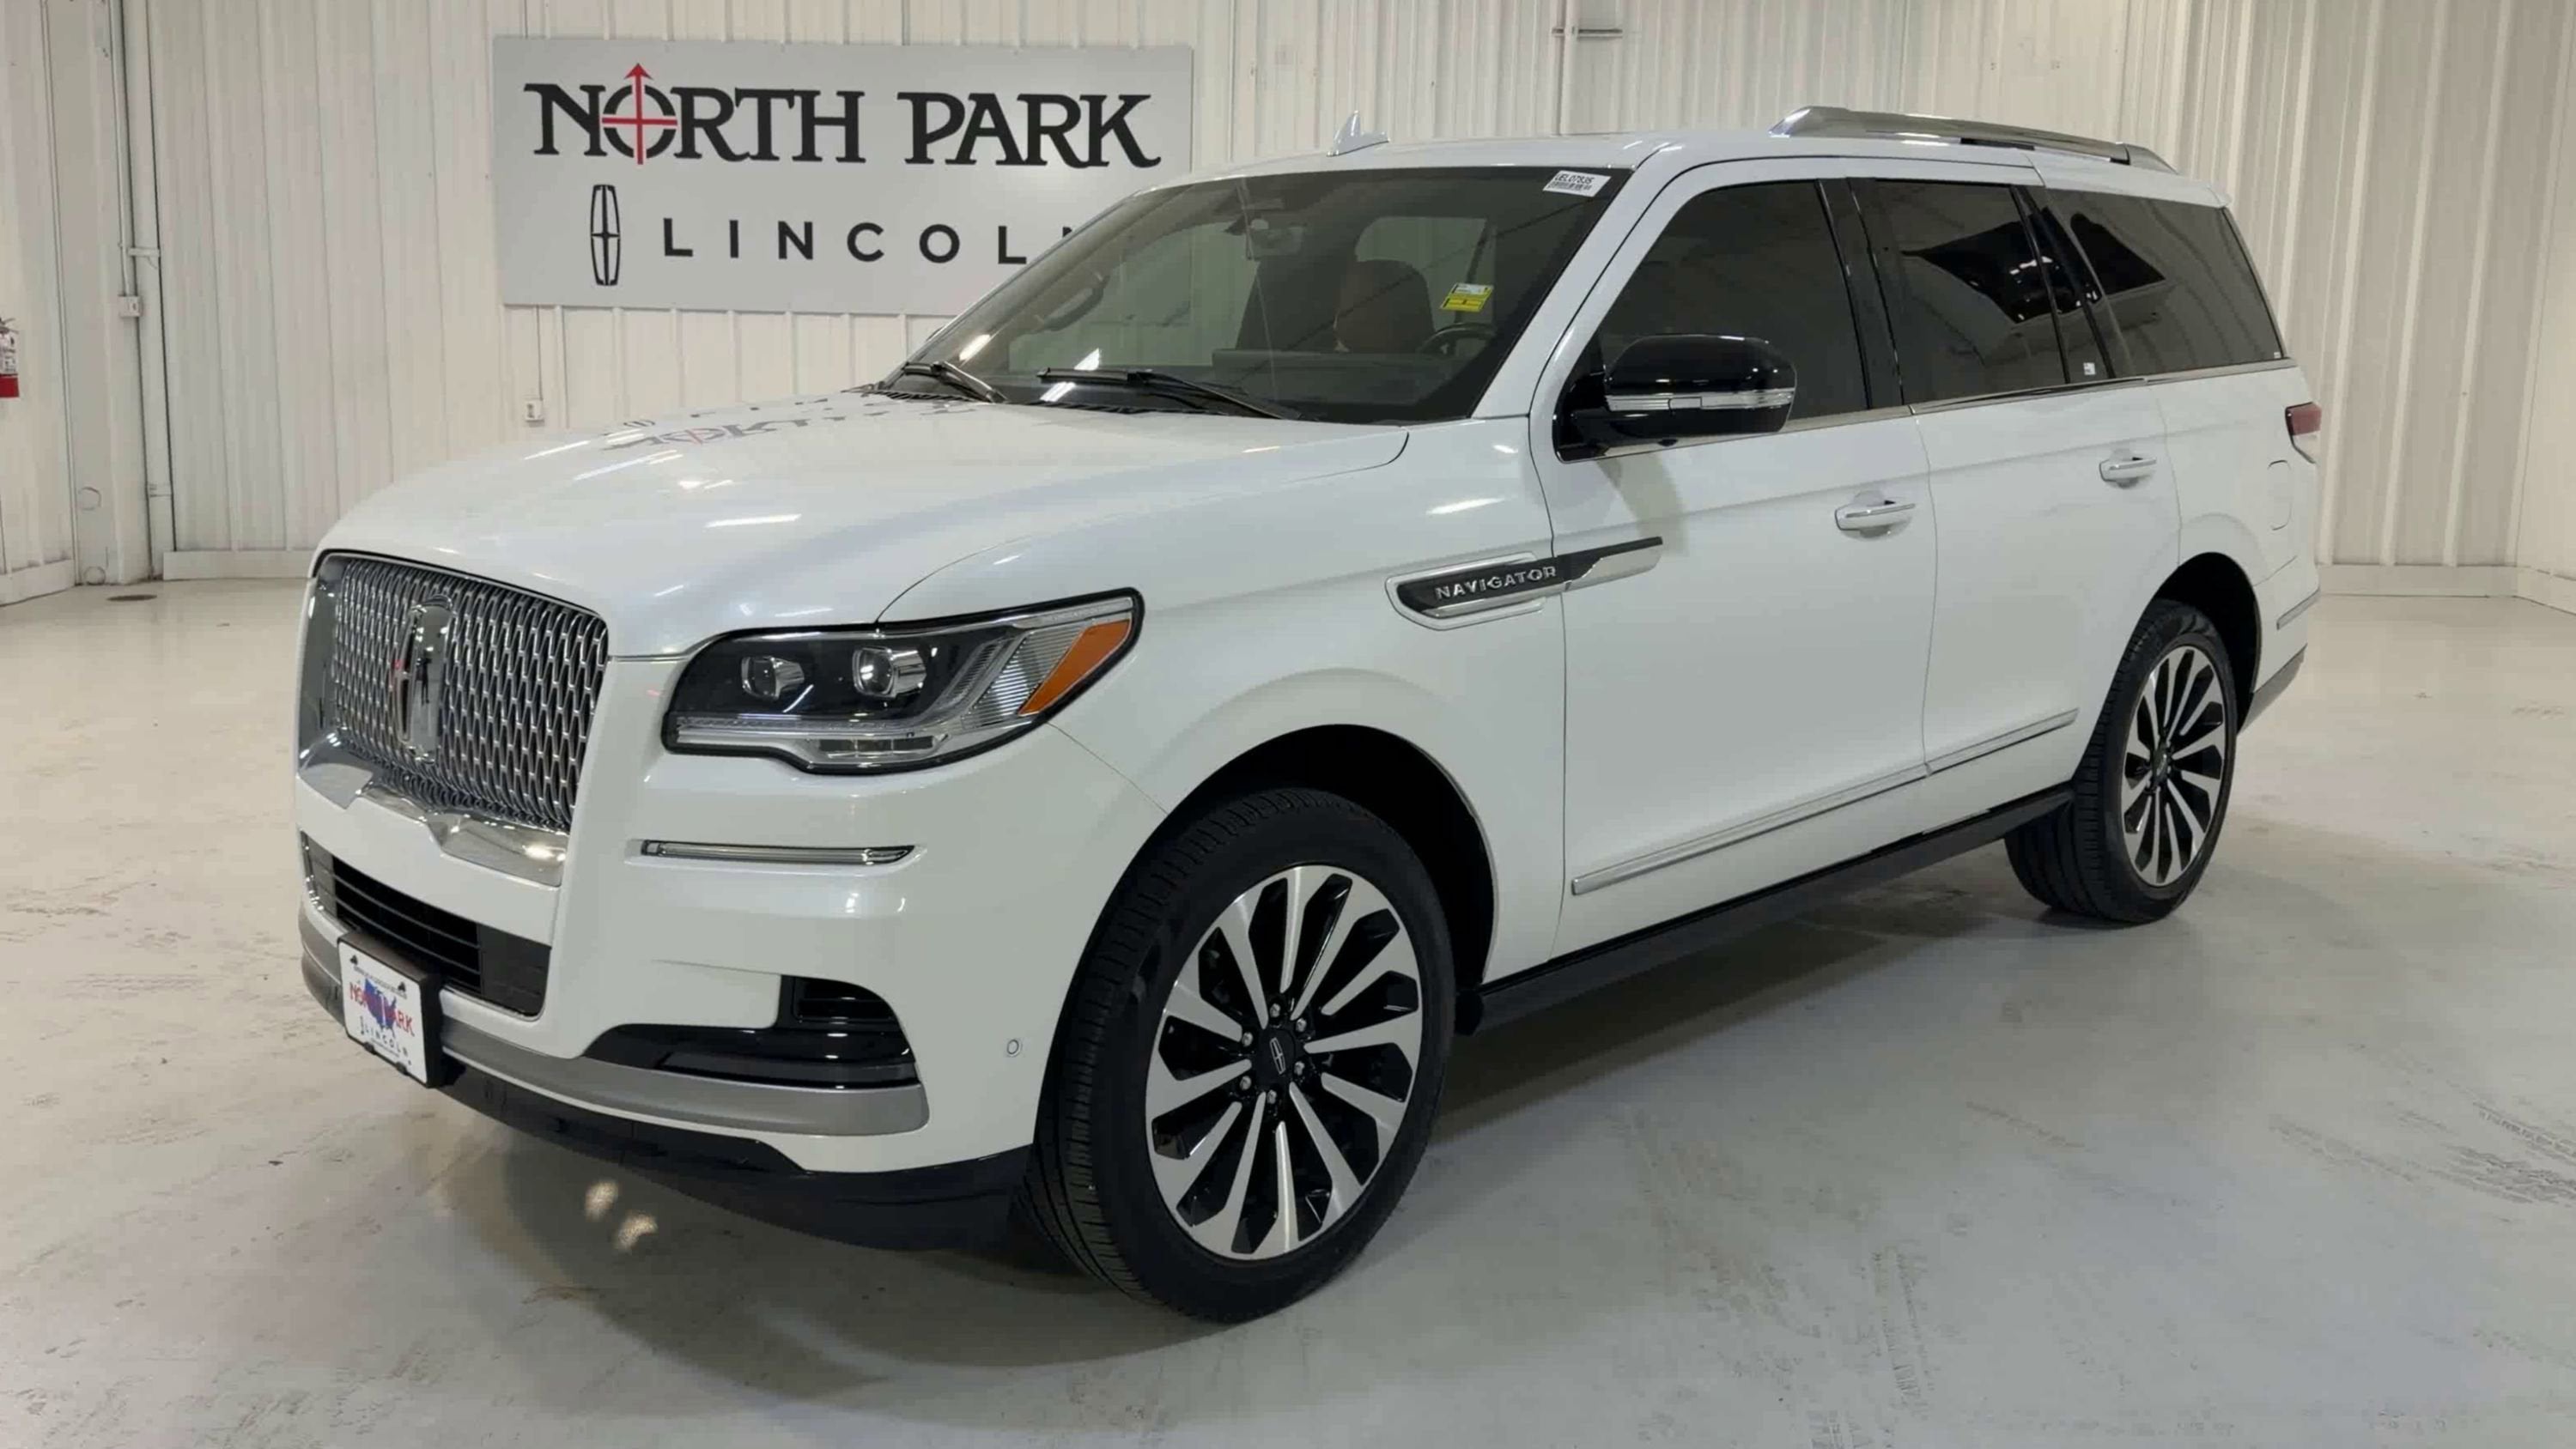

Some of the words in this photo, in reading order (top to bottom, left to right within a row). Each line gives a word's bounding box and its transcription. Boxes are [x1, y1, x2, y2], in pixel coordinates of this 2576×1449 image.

[523, 82, 866, 166] NORTH
[896, 90, 1163, 169] PARK
[662, 216, 1072, 264] LINCOL
[1435, 566, 1557, 600] NAVIGATOR
